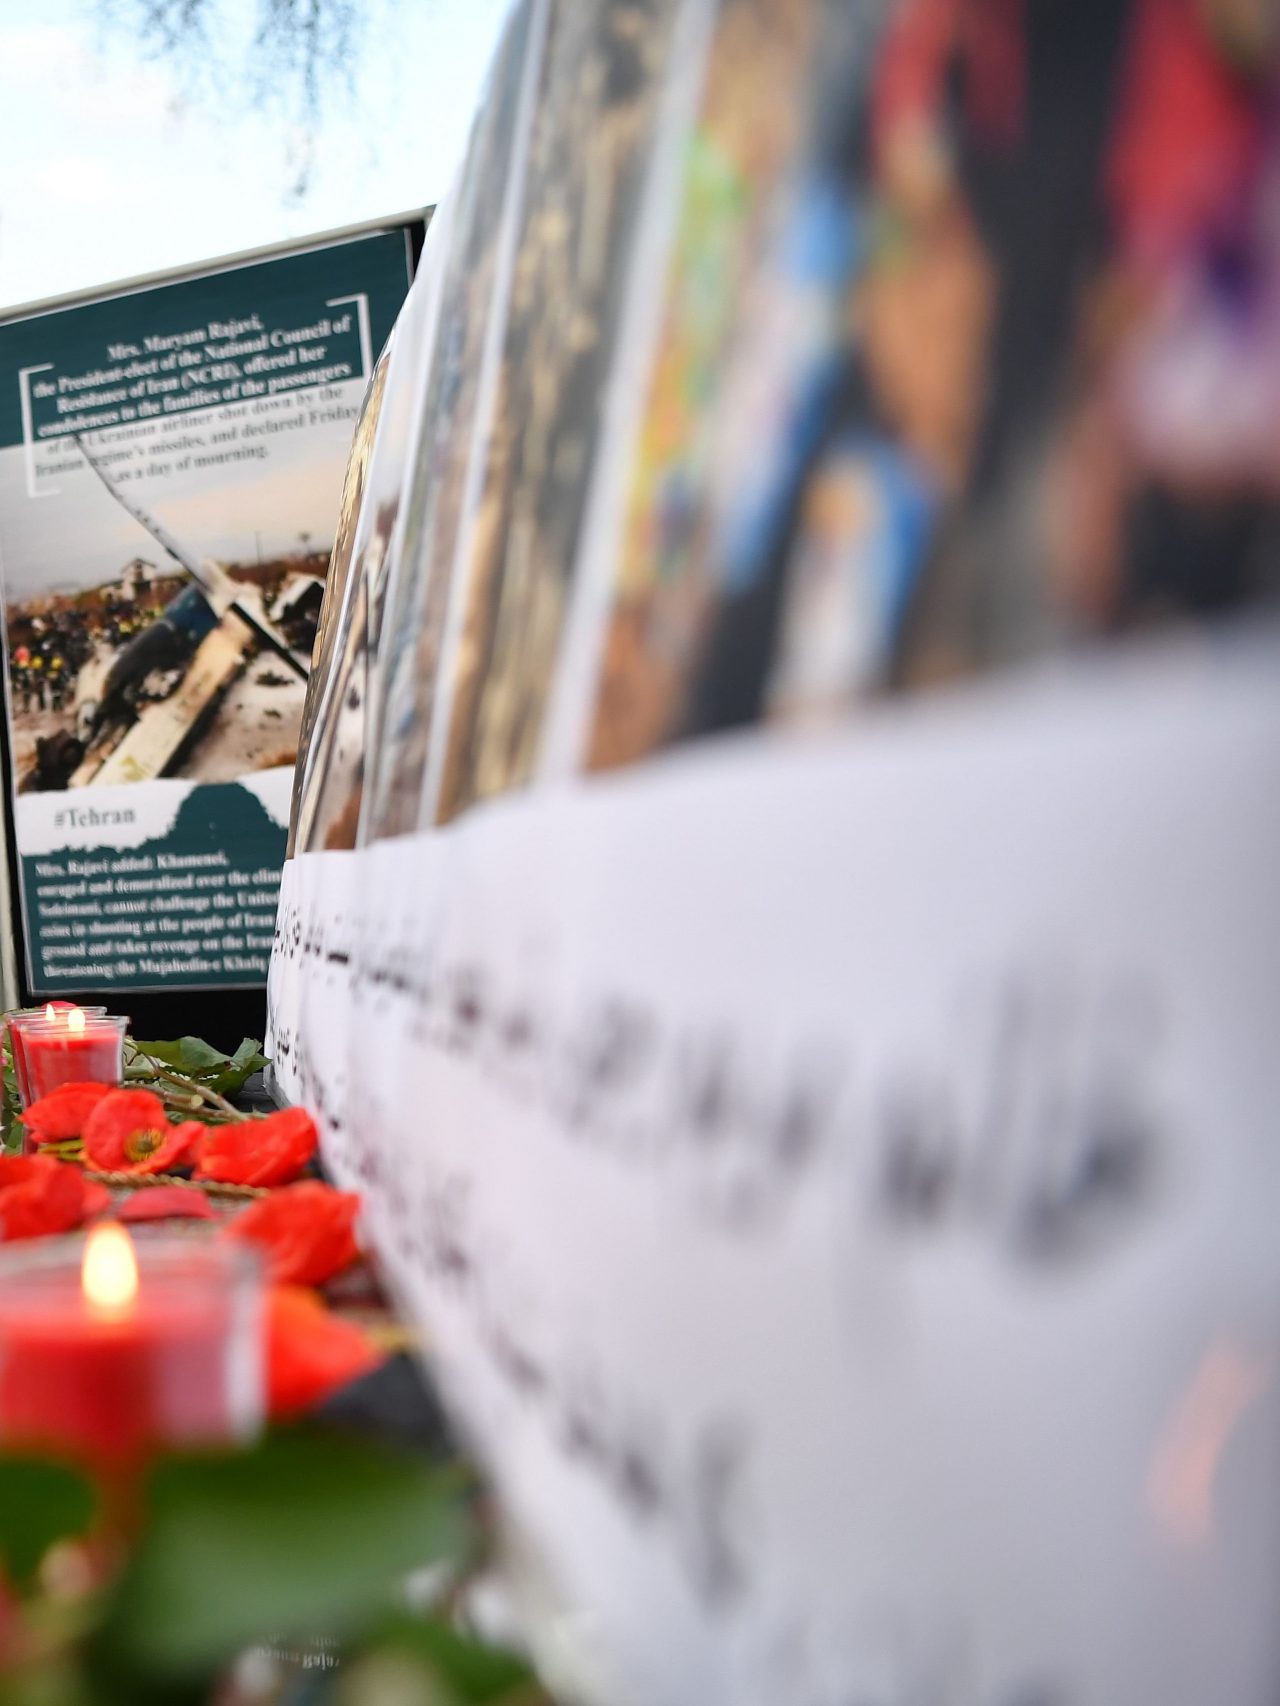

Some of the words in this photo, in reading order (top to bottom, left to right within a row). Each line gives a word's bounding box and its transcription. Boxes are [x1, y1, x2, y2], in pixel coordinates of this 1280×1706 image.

[107, 341, 140, 362] Mrs.
[143, 328, 207, 352] Maryam
[208, 313, 264, 340] Rajavi,
[160, 350, 177, 371] of
[178, 350, 203, 367] the
[204, 334, 270, 362] National
[271, 319, 332, 347] Council
[332, 313, 352, 334] of
[128, 379, 146, 398] of
[146, 377, 180, 395] Iran
[243, 348, 297, 375] offered
[298, 344, 328, 363] her
[121, 404, 136, 421] to
[137, 400, 161, 418] the
[163, 388, 220, 412] families
[221, 382, 240, 400] of
[241, 377, 266, 397] the
[268, 362, 353, 395] passengers
[87, 424, 157, 447] Ukrainian
[161, 411, 215, 433] airliner
[217, 406, 248, 422] shot
[250, 397, 293, 416] down
[296, 391, 316, 410] by
[318, 384, 344, 400] the
[148, 436, 207, 456] missiles,
[210, 427, 238, 445] and
[240, 411, 307, 438] declared
[308, 403, 360, 424] Friday
[146, 462, 171, 479] day
[175, 458, 191, 473] of
[194, 444, 269, 468] mourning.
[55, 806, 136, 829] #Tehran
[156, 849, 230, 869] Khamenei,
[195, 874, 225, 888] over
[227, 869, 250, 887] the
[251, 867, 282, 885] elim
[149, 894, 210, 913] challenge
[212, 891, 235, 908] the
[158, 916, 179, 932] the
[181, 914, 225, 935] people
[226, 912, 242, 929] of
[201, 936, 219, 951] on
[221, 933, 244, 950] the
